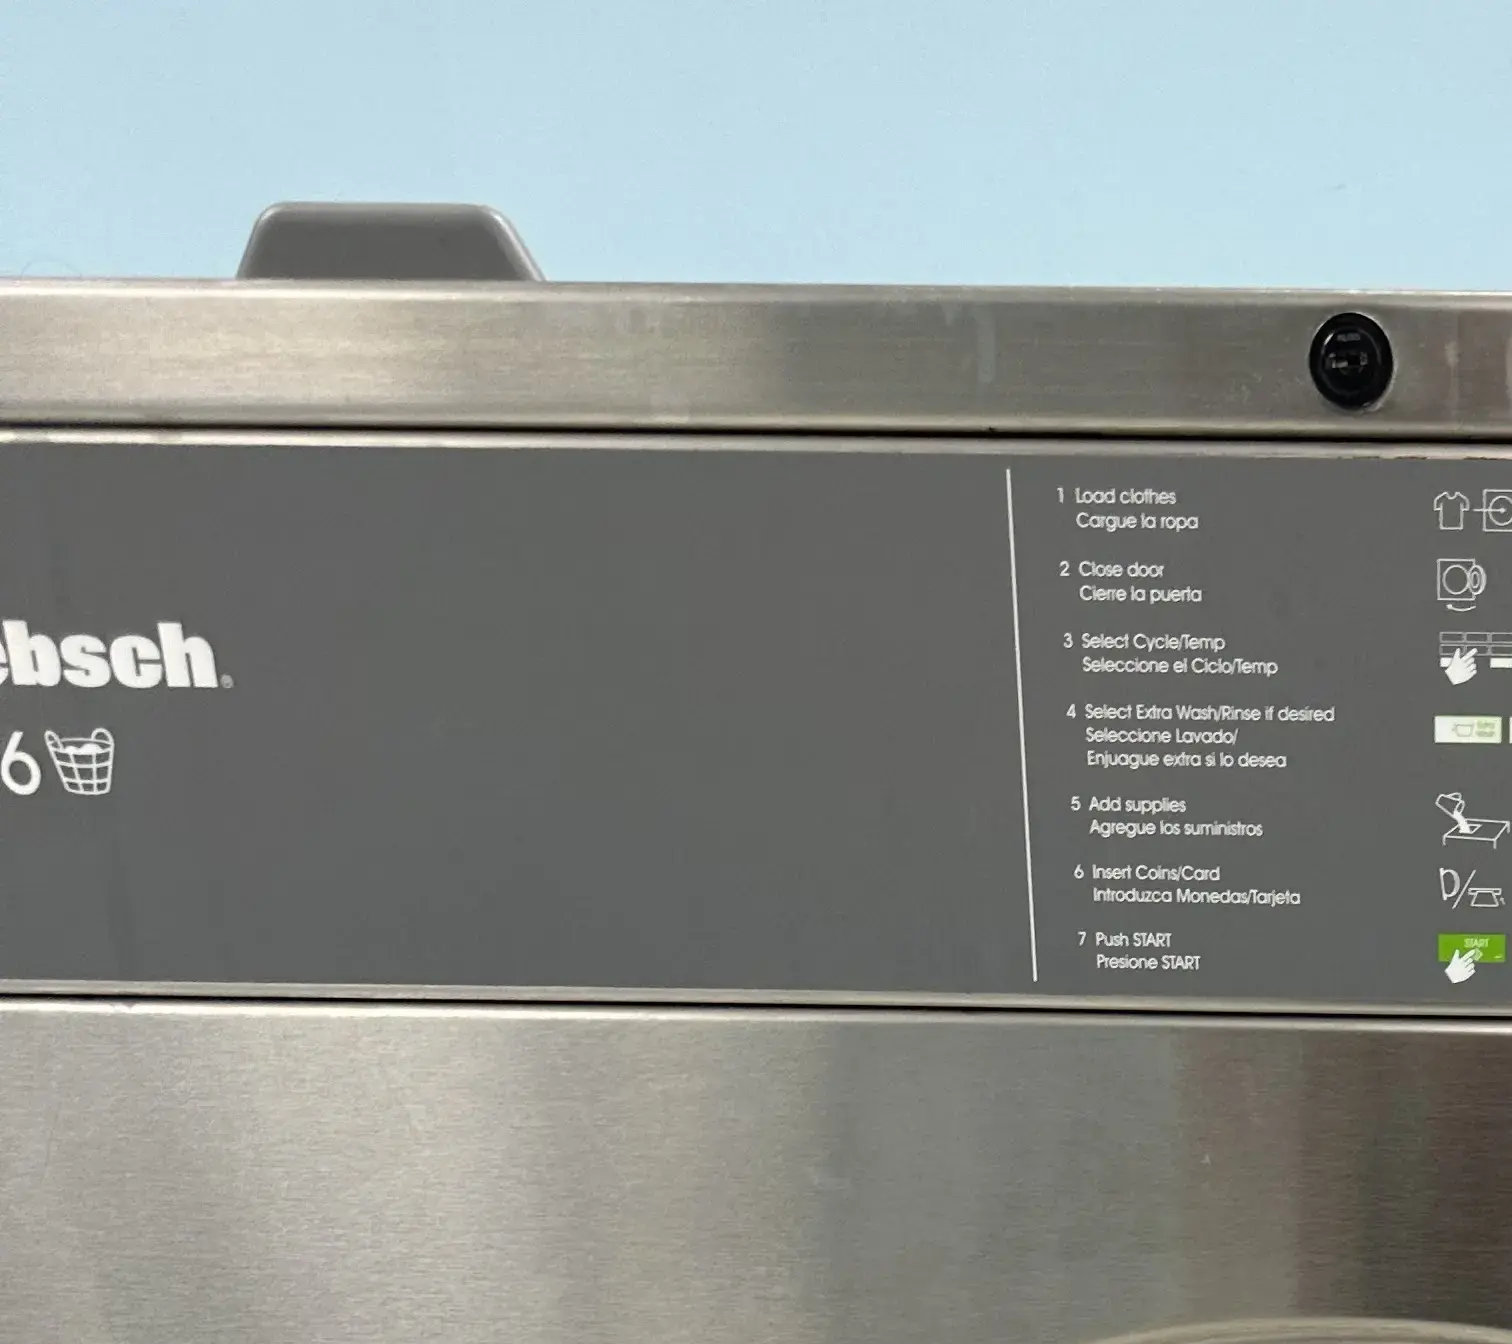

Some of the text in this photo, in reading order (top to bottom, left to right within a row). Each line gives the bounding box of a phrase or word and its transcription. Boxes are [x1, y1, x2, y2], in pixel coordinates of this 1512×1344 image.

[1057, 488, 1176, 504] 1 Load clothes
[1076, 512, 1198, 532] Cargue la ropa
[1060, 561, 1164, 577] 2 Close door
[1080, 585, 1202, 604] Cierre la puerta
[1064, 633, 1225, 652] 3 Select Cycle/Temp
[0, 620, 218, 688] bsch
[1083, 656, 1278, 677] Seleccione el Ciclo/Temp
[1066, 704, 1334, 721] 4 Select Extra Wash/Rinse if desired
[1086, 727, 1238, 745] Seleccione Lavado/
[1087, 750, 1287, 769] Enjuague extra si lo desea
[1071, 796, 1186, 815] 5 Add supplies
[1090, 819, 1263, 838] Agregue los suministros
[1074, 864, 1220, 881] 6 Insert Coins/Card
[1093, 887, 1300, 907] Introduzca Monedas/Tarjeta
[1078, 932, 1171, 947] 7 Push START
[1097, 954, 1201, 970] Presione START
